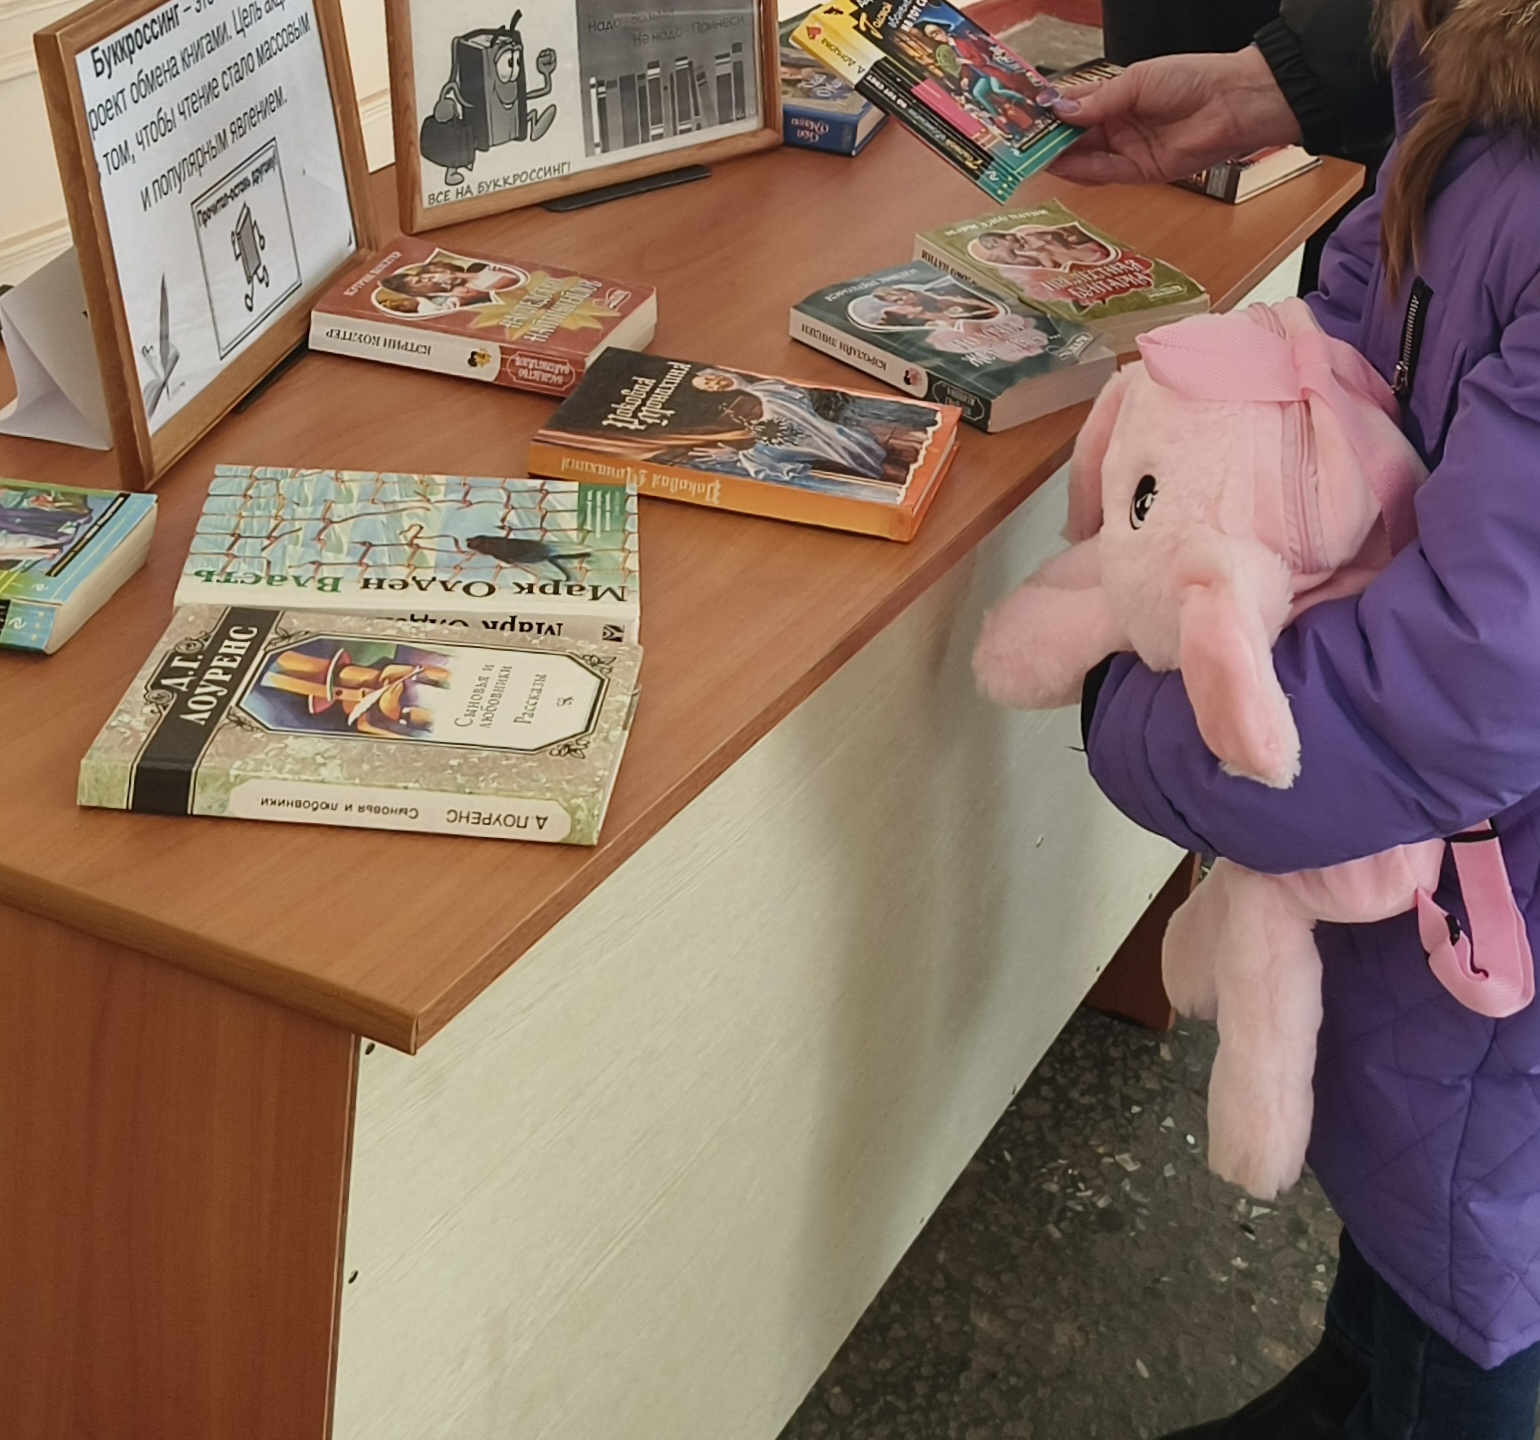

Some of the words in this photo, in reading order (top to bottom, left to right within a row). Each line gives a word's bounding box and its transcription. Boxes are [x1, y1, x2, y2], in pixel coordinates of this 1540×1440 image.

[90, 2, 181, 79] Буккроссинг
[588, 18, 622, 33] Надо
[633, 34, 650, 46] Не
[652, 28, 683, 42] надо
[692, 15, 744, 35] Принеси
[88, 87, 128, 140] роект
[130, 56, 181, 105] обмена
[179, 21, 232, 73] книгами.
[232, 0, 263, 39] Цель
[103, 139, 136, 175] том,
[135, 105, 177, 154] чтобы
[178, 76, 220, 123] чтение
[221, 51, 256, 95] стало
[255, 11, 311, 66] массовым
[140, 187, 152, 212] и
[152, 132, 229, 203] популярным
[229, 85, 288, 146] явлением.
[427, 189, 451, 207] ВСЕ
[455, 184, 474, 201] НА
[477, 161, 571, 195] БУККРОССИНГ!
[325, 327, 380, 348] КОУЛТЕР
[383, 336, 432, 356] КЭТРИН
[652, 474, 721, 504] Роковая
[193, 568, 342, 593] Власть
[360, 576, 496, 598] Олден
[512, 580, 628, 602] Марк
[171, 655, 202, 694] Д.Г.
[179, 624, 259, 728] ЛОУРЕНС
[453, 674, 491, 728] Сыновья
[484, 664, 514, 730] любовники
[513, 672, 548, 726] Рассказы
[260, 796, 338, 813] любовники
[344, 803, 352, 813] и
[357, 801, 419, 820] Сыновья
